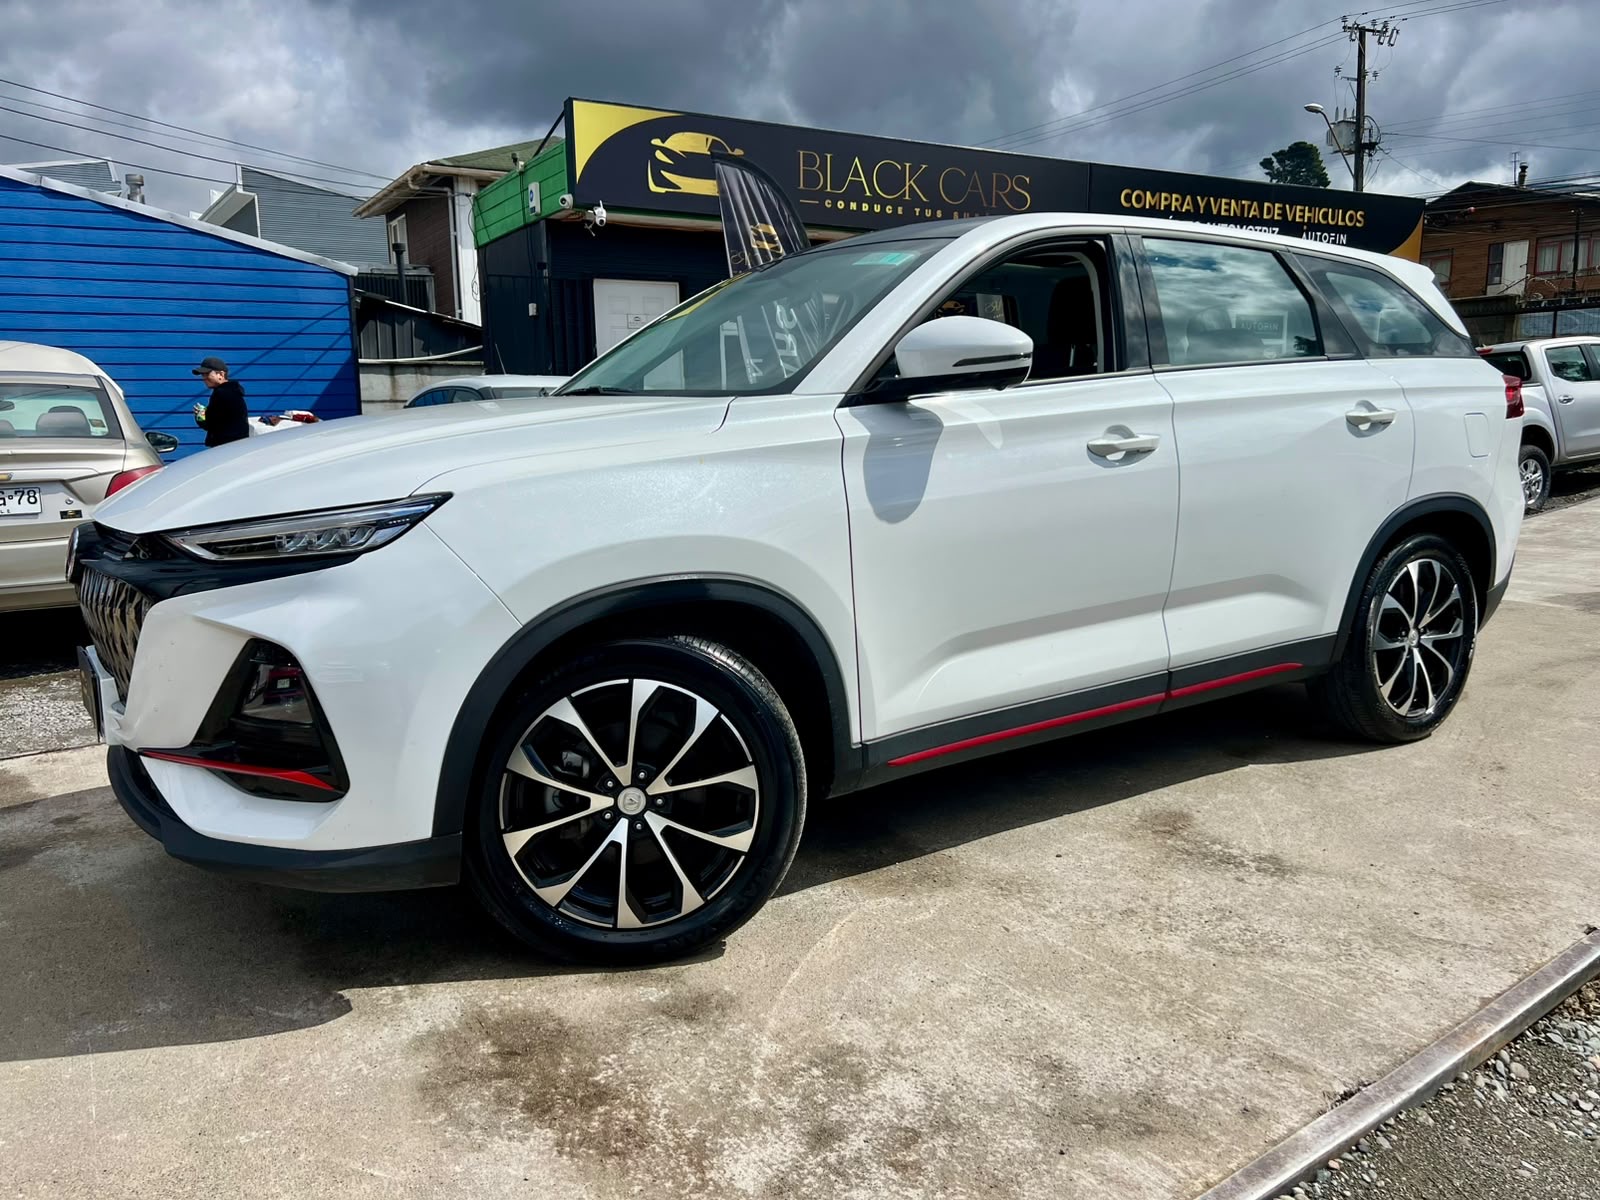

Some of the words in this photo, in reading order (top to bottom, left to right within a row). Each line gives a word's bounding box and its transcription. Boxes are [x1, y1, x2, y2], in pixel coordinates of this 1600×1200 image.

[797, 150, 929, 202] BLACK
[939, 167, 1031, 211] CARS
[824, 199, 903, 215] CONDUCE
[914, 207, 942, 218] TUS
[1120, 188, 1194, 213] COMPRA
[1197, 196, 1208, 214] Y
[1210, 198, 1260, 219] VENTA
[1263, 202, 1282, 220] DE
[1285, 204, 1365, 228] VEHICULOS
[1301, 231, 1347, 245] AUTOFIN
